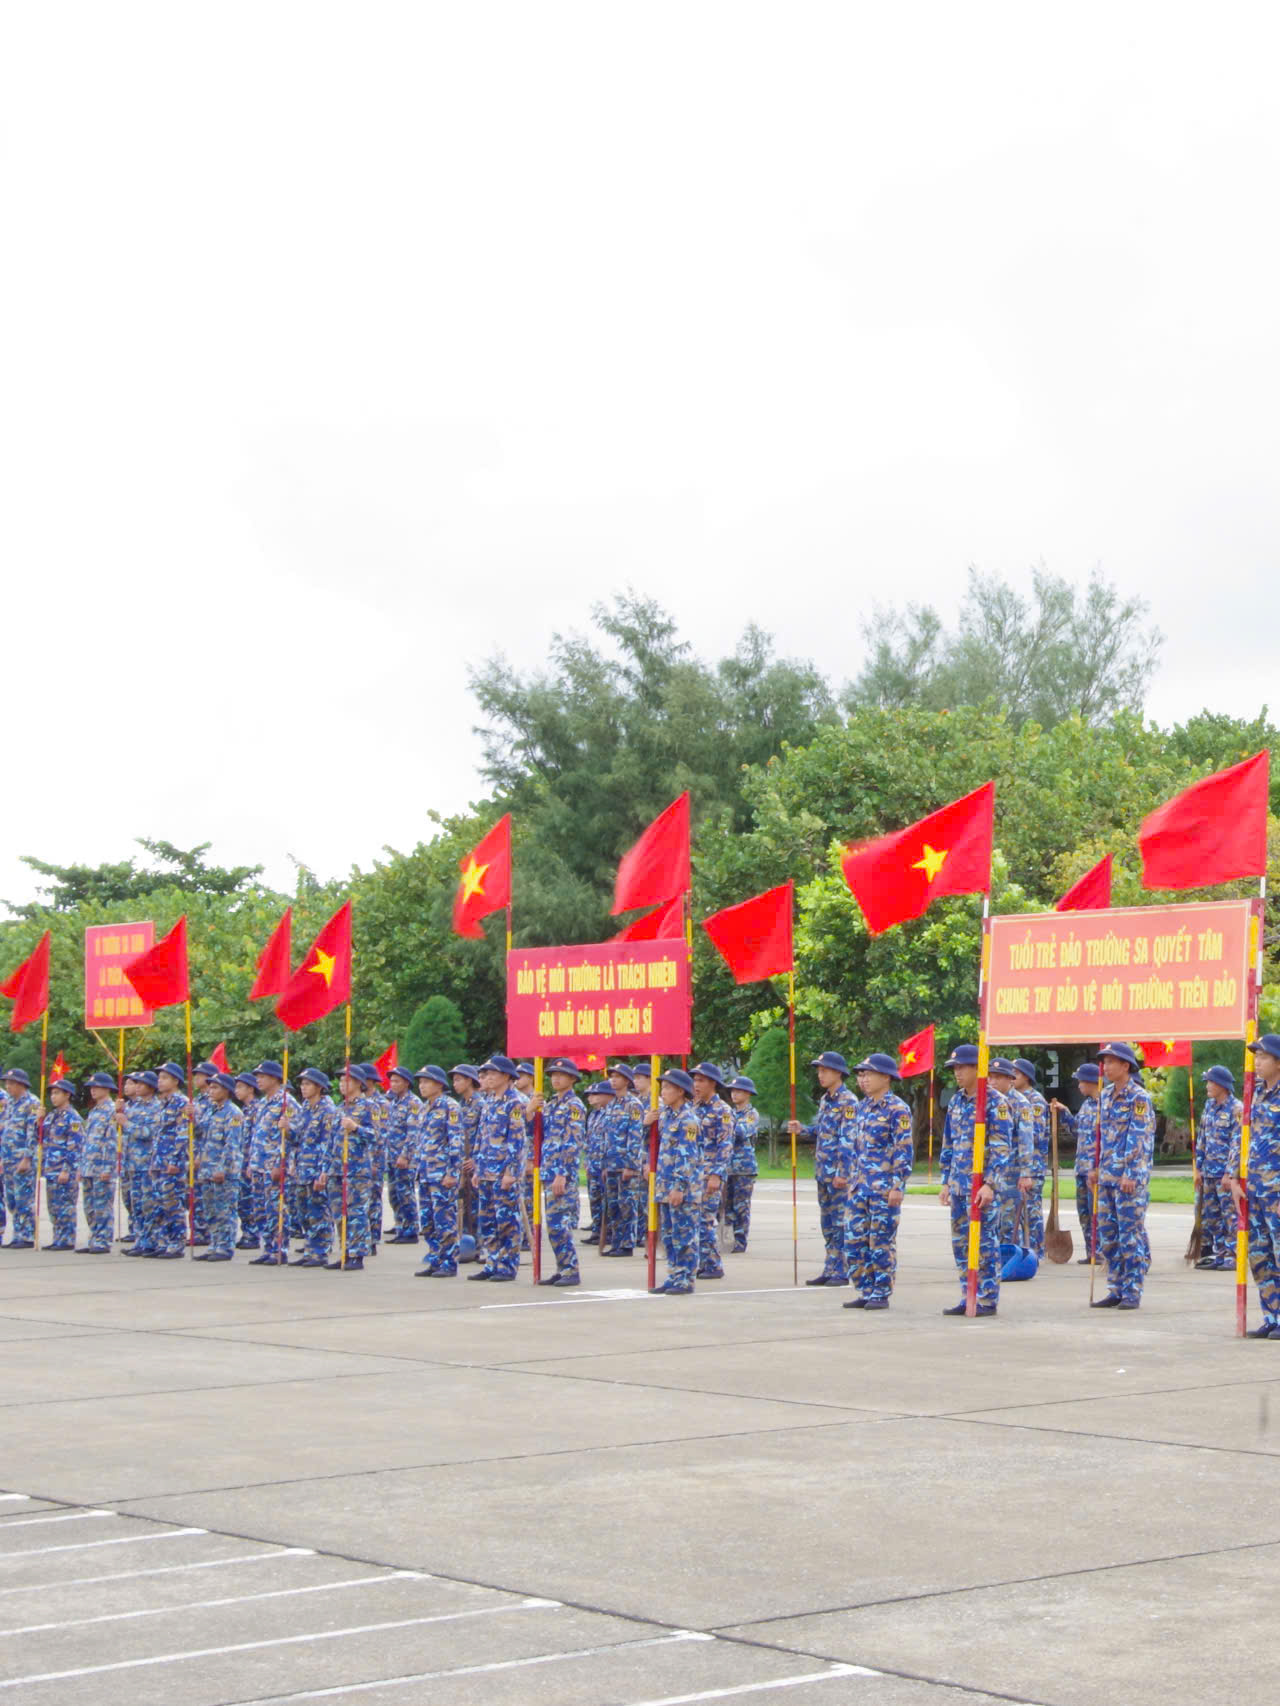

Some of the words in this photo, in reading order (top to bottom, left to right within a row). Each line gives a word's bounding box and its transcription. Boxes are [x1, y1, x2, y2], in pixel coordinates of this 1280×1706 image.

[1009, 928, 1034, 970] TUỔI
[1035, 933, 1057, 969] TRẺ
[1059, 931, 1082, 967] ĐẢO
[1085, 929, 1130, 966] TRƯỜNG
[1133, 936, 1149, 964] SA
[1153, 924, 1193, 968] QUYẾT
[1198, 927, 1223, 961] TÂM
[602, 960, 615, 991] LÀ
[617, 957, 646, 990] TRÁCH
[995, 986, 1030, 1014] CHUNG
[1034, 986, 1052, 1013] TAY
[1056, 976, 1079, 1013] BẢO
[1083, 978, 1097, 1016] VỆ
[1101, 976, 1123, 1011] MÔI
[1128, 973, 1174, 1010] TRƯỜNG
[1178, 975, 1209, 1009] TRÊN
[1212, 969, 1237, 1008] ĐẢO
